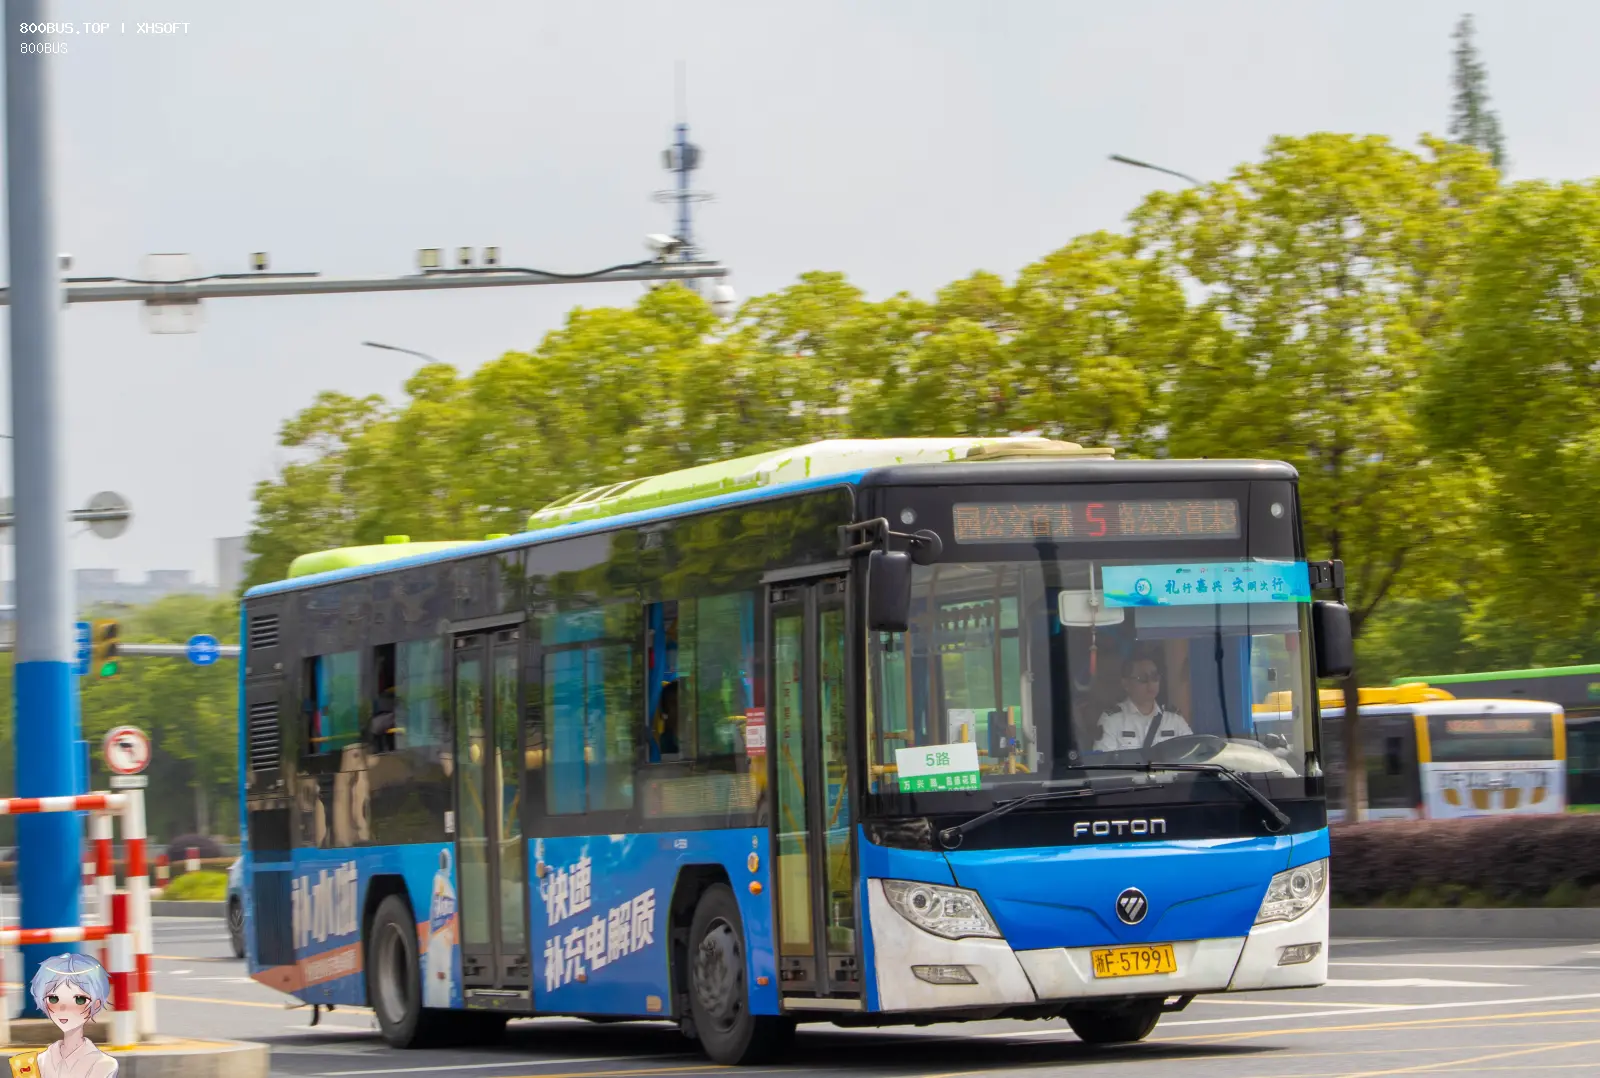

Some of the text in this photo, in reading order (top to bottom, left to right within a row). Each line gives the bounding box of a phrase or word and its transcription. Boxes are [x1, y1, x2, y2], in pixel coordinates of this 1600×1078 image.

[1085, 502, 1107, 537] 5
[1164, 577, 1224, 595] 礼行嘉兴
[925, 751, 950, 766] 5路
[1073, 818, 1167, 838] FOTON
[543, 856, 592, 927] 快速
[544, 888, 656, 992] 补充电解质
